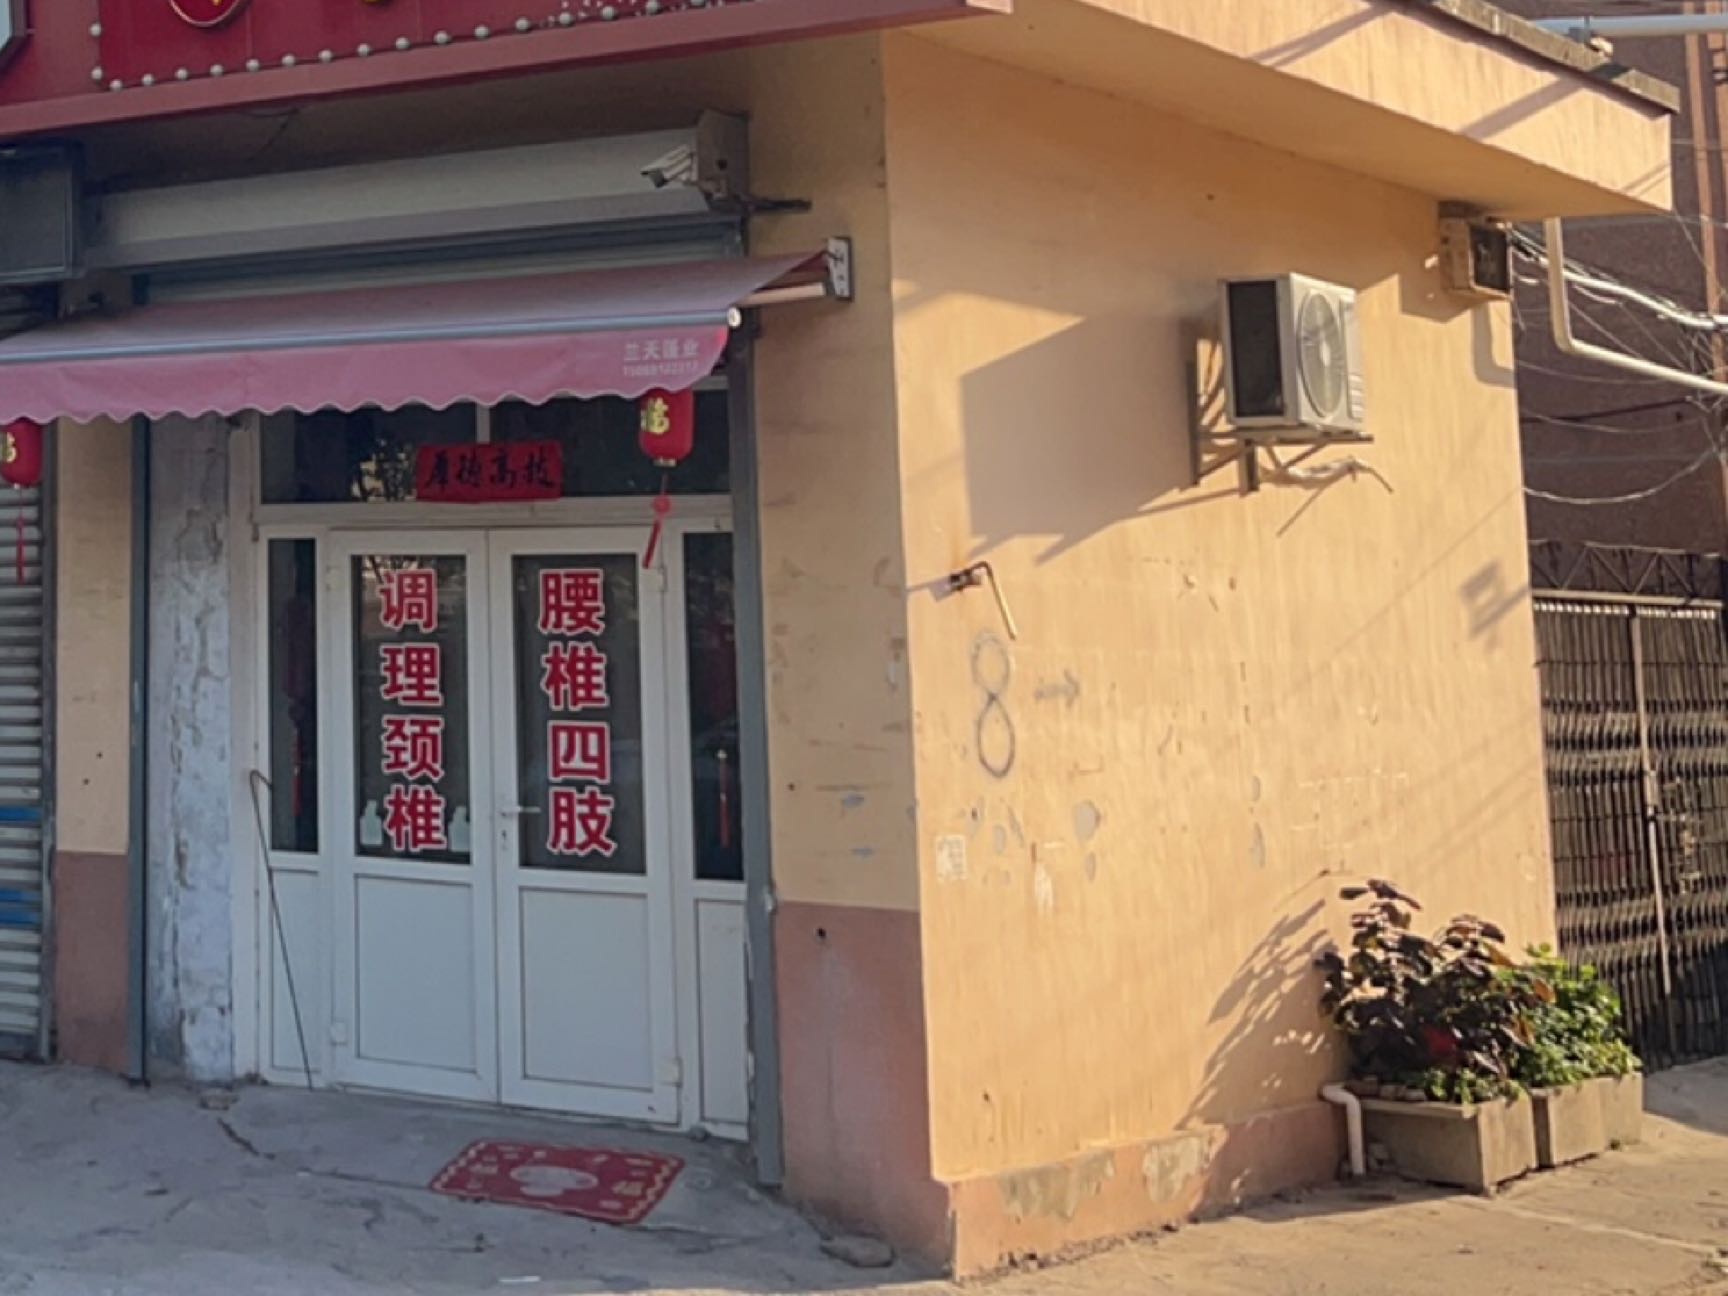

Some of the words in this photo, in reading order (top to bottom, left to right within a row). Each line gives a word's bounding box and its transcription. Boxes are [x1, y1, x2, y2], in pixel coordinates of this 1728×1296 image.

[379, 569, 447, 851] 调理颈椎
[538, 569, 617, 855] 腰椎四肢
